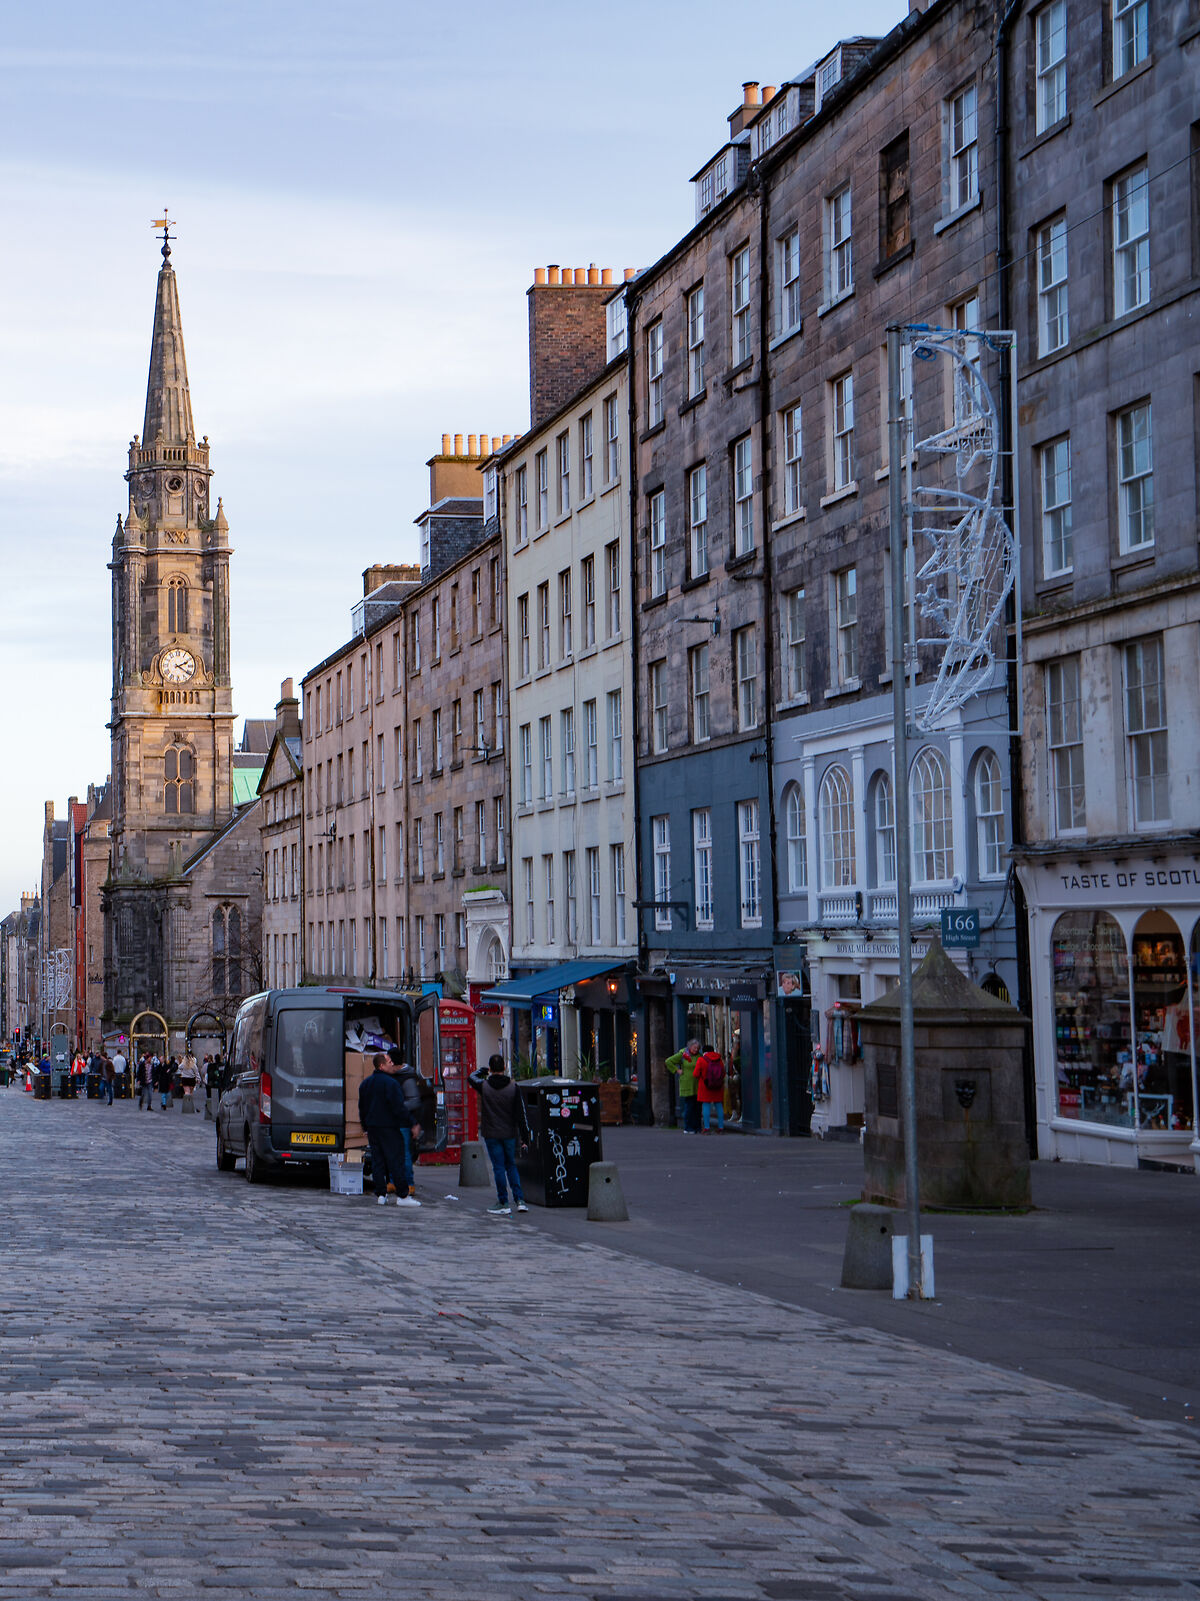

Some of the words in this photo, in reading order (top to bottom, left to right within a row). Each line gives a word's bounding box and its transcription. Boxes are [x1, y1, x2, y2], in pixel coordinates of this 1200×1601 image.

[1061, 874, 1110, 889] TASTE
[1116, 872, 1138, 887] OF
[1144, 869, 1200, 886] SCOTL
[947, 914, 975, 931] 166
[945, 934, 960, 942] High
[836, 943, 857, 953] ROYAL
[857, 943, 872, 953] MILE
[872, 943, 900, 954] FACTORY
[315, 1135, 330, 1143] AYF
